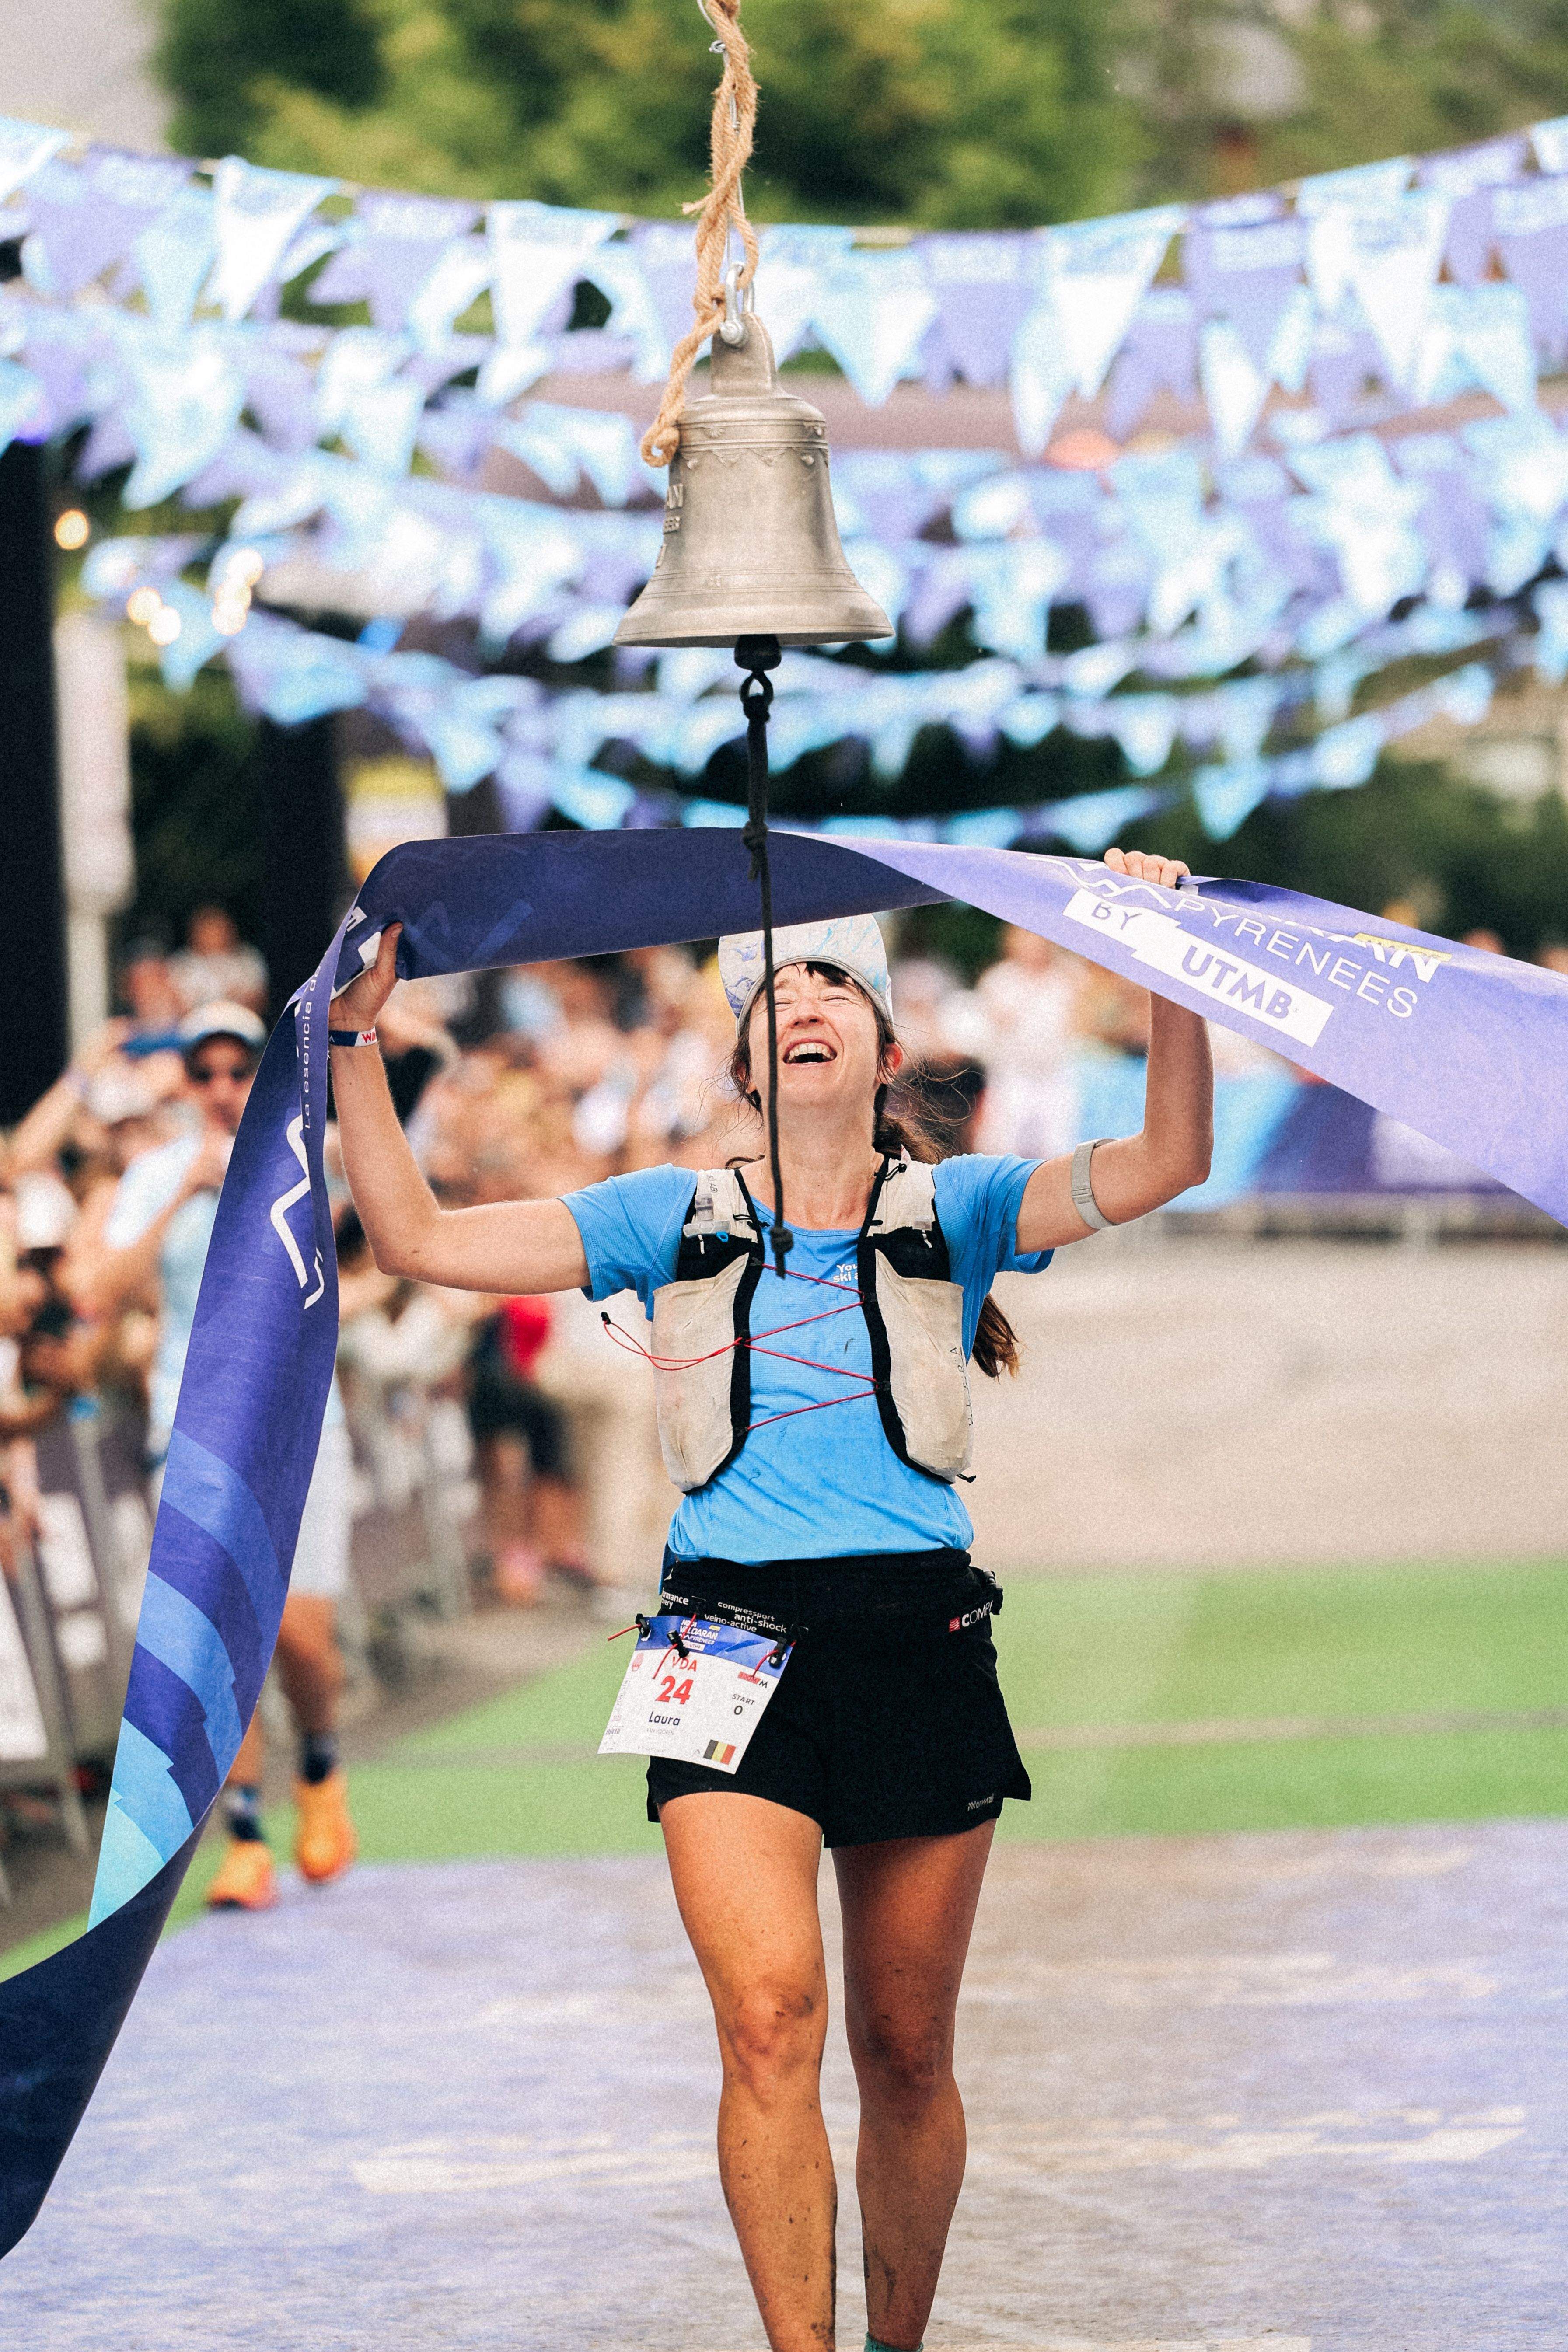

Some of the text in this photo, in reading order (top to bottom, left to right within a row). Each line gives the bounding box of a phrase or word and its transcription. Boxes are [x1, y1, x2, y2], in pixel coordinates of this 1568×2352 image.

[1091, 902, 1142, 930] BY
[1182, 945, 1292, 1019] UTMB
[1174, 898, 1418, 1018] PYRENEES
[302, 1002, 312, 1093] esencia
[305, 1104, 310, 1129] La
[833, 1271, 852, 1282] ski
[717, 1602, 775, 1622] compressport
[704, 1614, 757, 1633] veino-active
[734, 1613, 787, 1633] anti-shock
[690, 1635, 716, 1645] PYRENEES
[672, 1656, 698, 1672] VDA
[654, 1675, 694, 1705] 24
[732, 1694, 755, 1705] START
[649, 1711, 681, 1726] Laura
